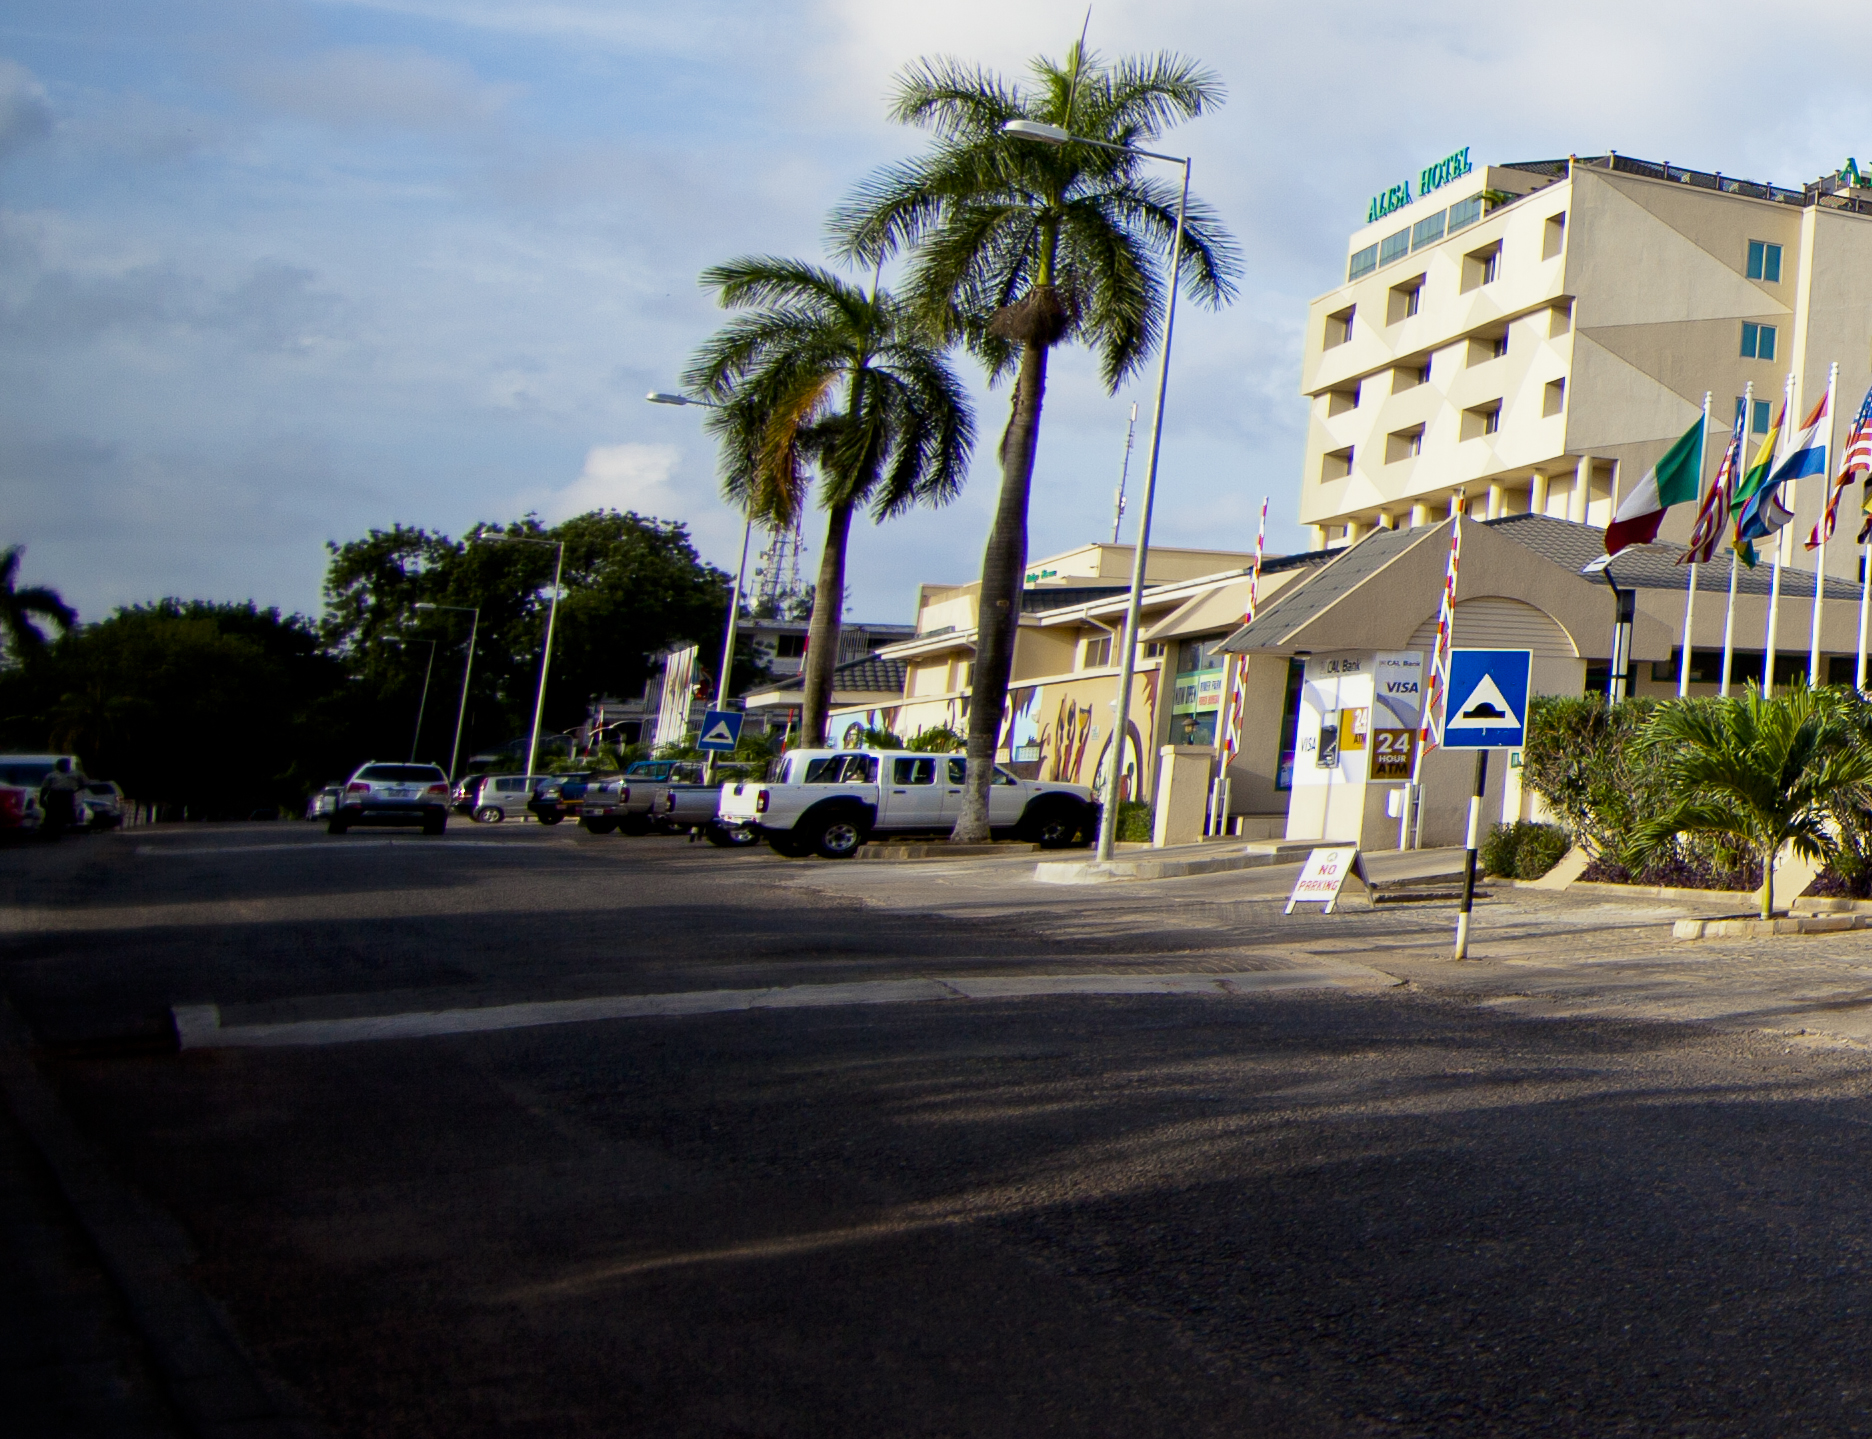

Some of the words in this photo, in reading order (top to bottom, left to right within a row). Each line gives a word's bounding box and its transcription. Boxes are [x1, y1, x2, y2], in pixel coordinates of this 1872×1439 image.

[1366, 180, 1413, 223] ALISA
[1418, 146, 1472, 197] HOTEL
[1342, 658, 1361, 672] Bank
[1386, 681, 1418, 693] VISA
[1354, 708, 1367, 724] 24
[1301, 737, 1316, 752] VISA
[1377, 733, 1410, 753] 24
[1379, 755, 1406, 763] HOUR
[1376, 763, 1408, 774] ATM
[1318, 864, 1337, 875] NO
[1297, 879, 1340, 891] PARKING
